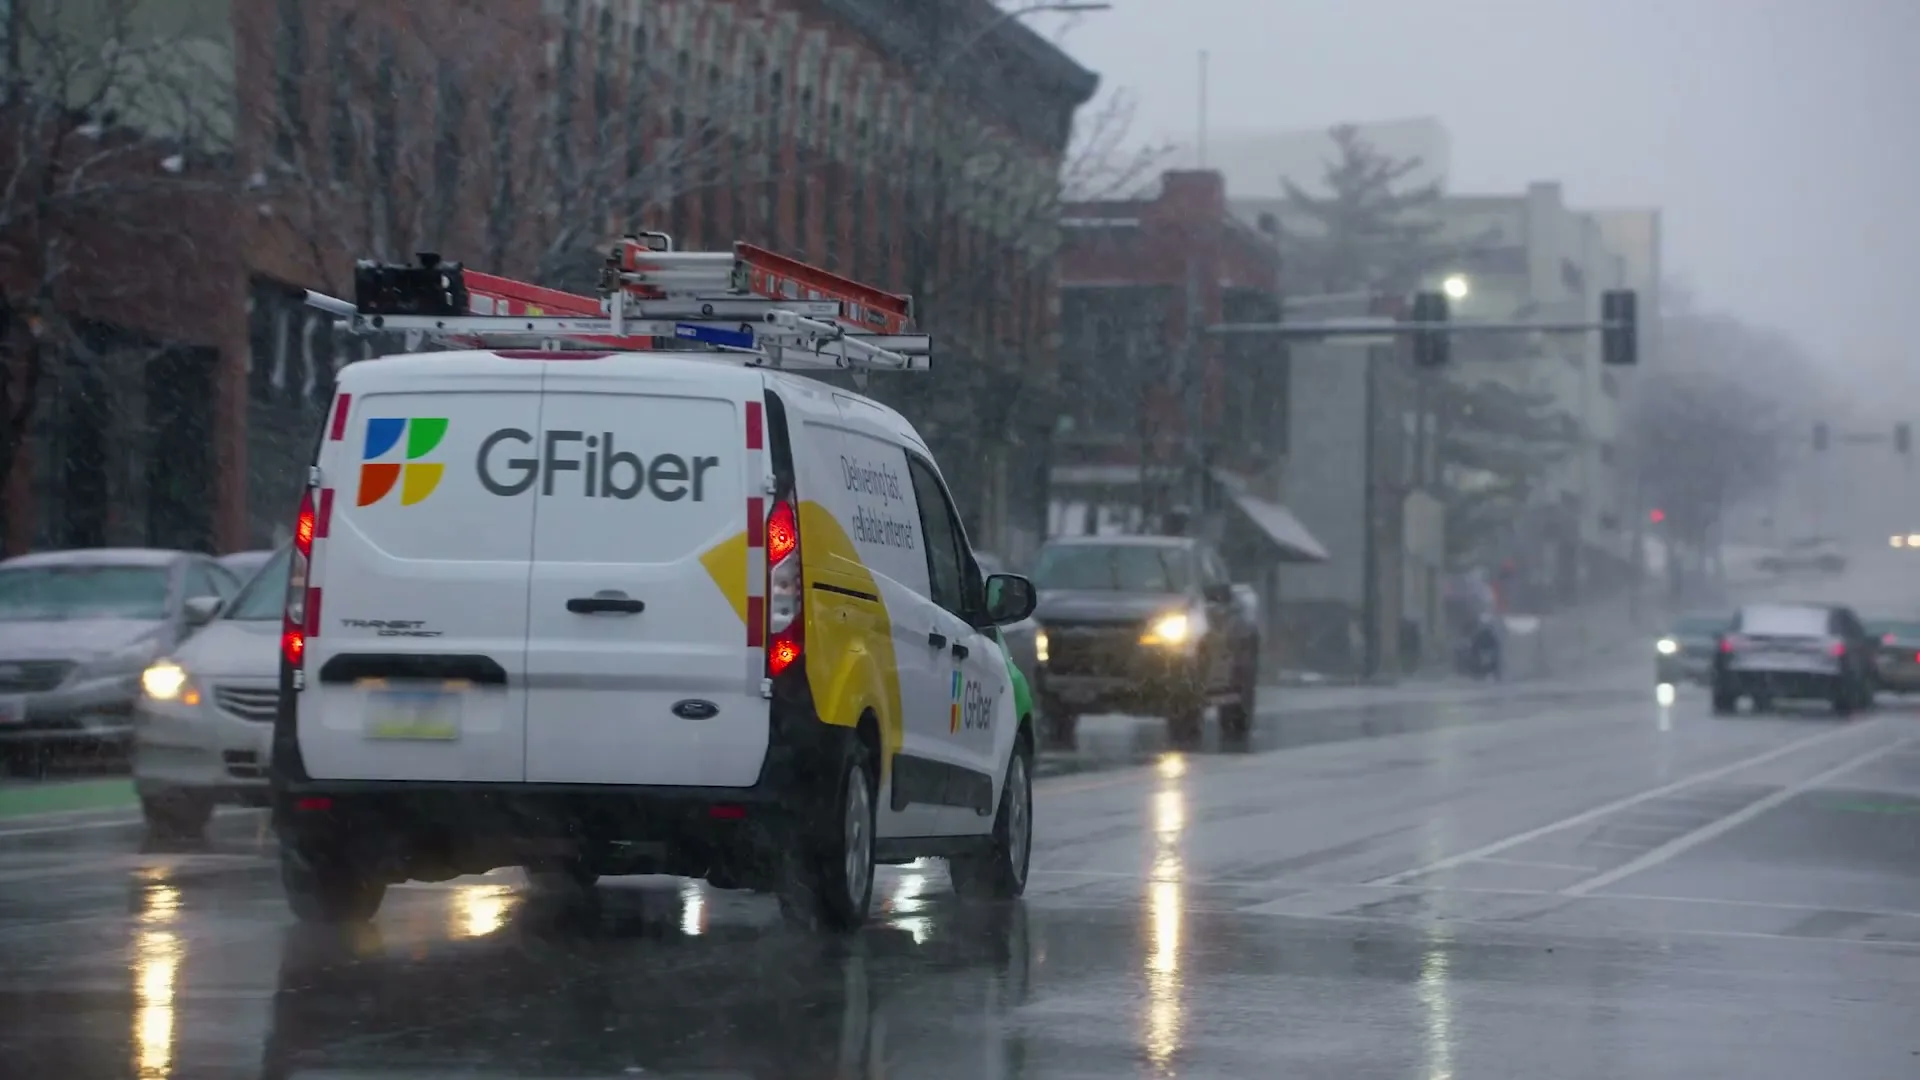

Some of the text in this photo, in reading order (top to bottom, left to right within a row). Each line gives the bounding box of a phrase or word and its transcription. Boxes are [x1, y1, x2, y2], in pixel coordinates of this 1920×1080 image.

[477, 427, 719, 502] GFiber
[841, 454, 888, 507] Delivering
[852, 504, 914, 550] reliable internet
[964, 680, 992, 730] GFiber
